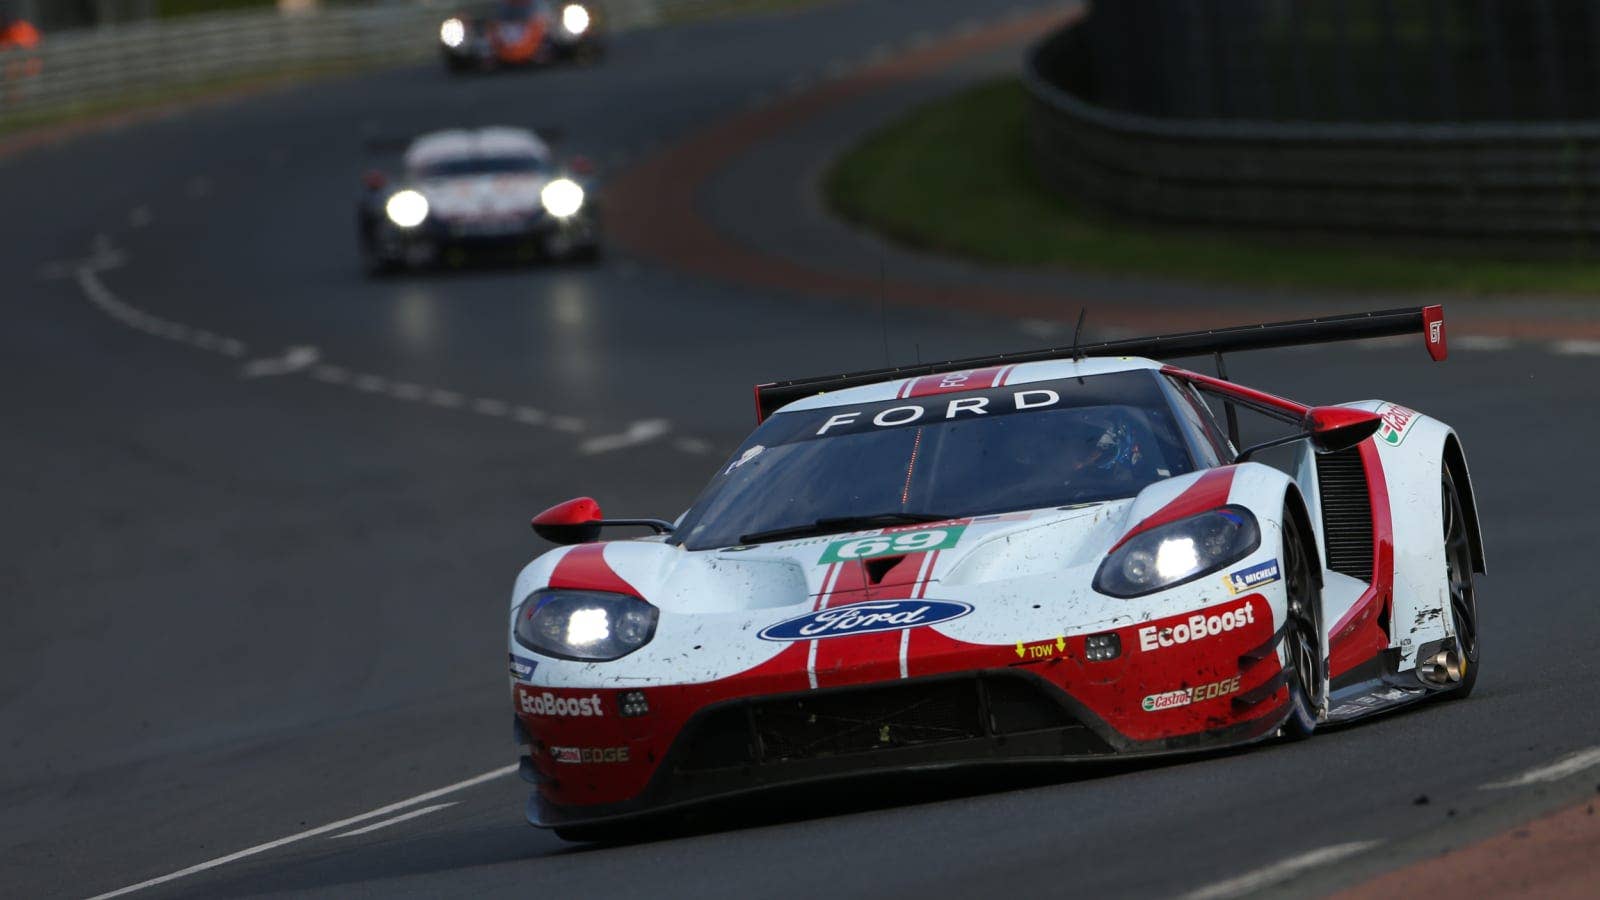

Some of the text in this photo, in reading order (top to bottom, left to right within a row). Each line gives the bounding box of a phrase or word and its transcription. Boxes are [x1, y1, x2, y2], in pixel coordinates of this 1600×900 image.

[816, 389, 1060, 436] FORD
[837, 529, 948, 558] 69
[1245, 566, 1278, 584] MICHELIN
[800, 603, 931, 636] Ford
[1139, 601, 1255, 652] EcoBoost
[1029, 645, 1053, 658] TOW
[519, 689, 604, 716] EcoBoost
[1154, 676, 1242, 708] Castrol EDGE
[581, 747, 630, 762] EDGE
